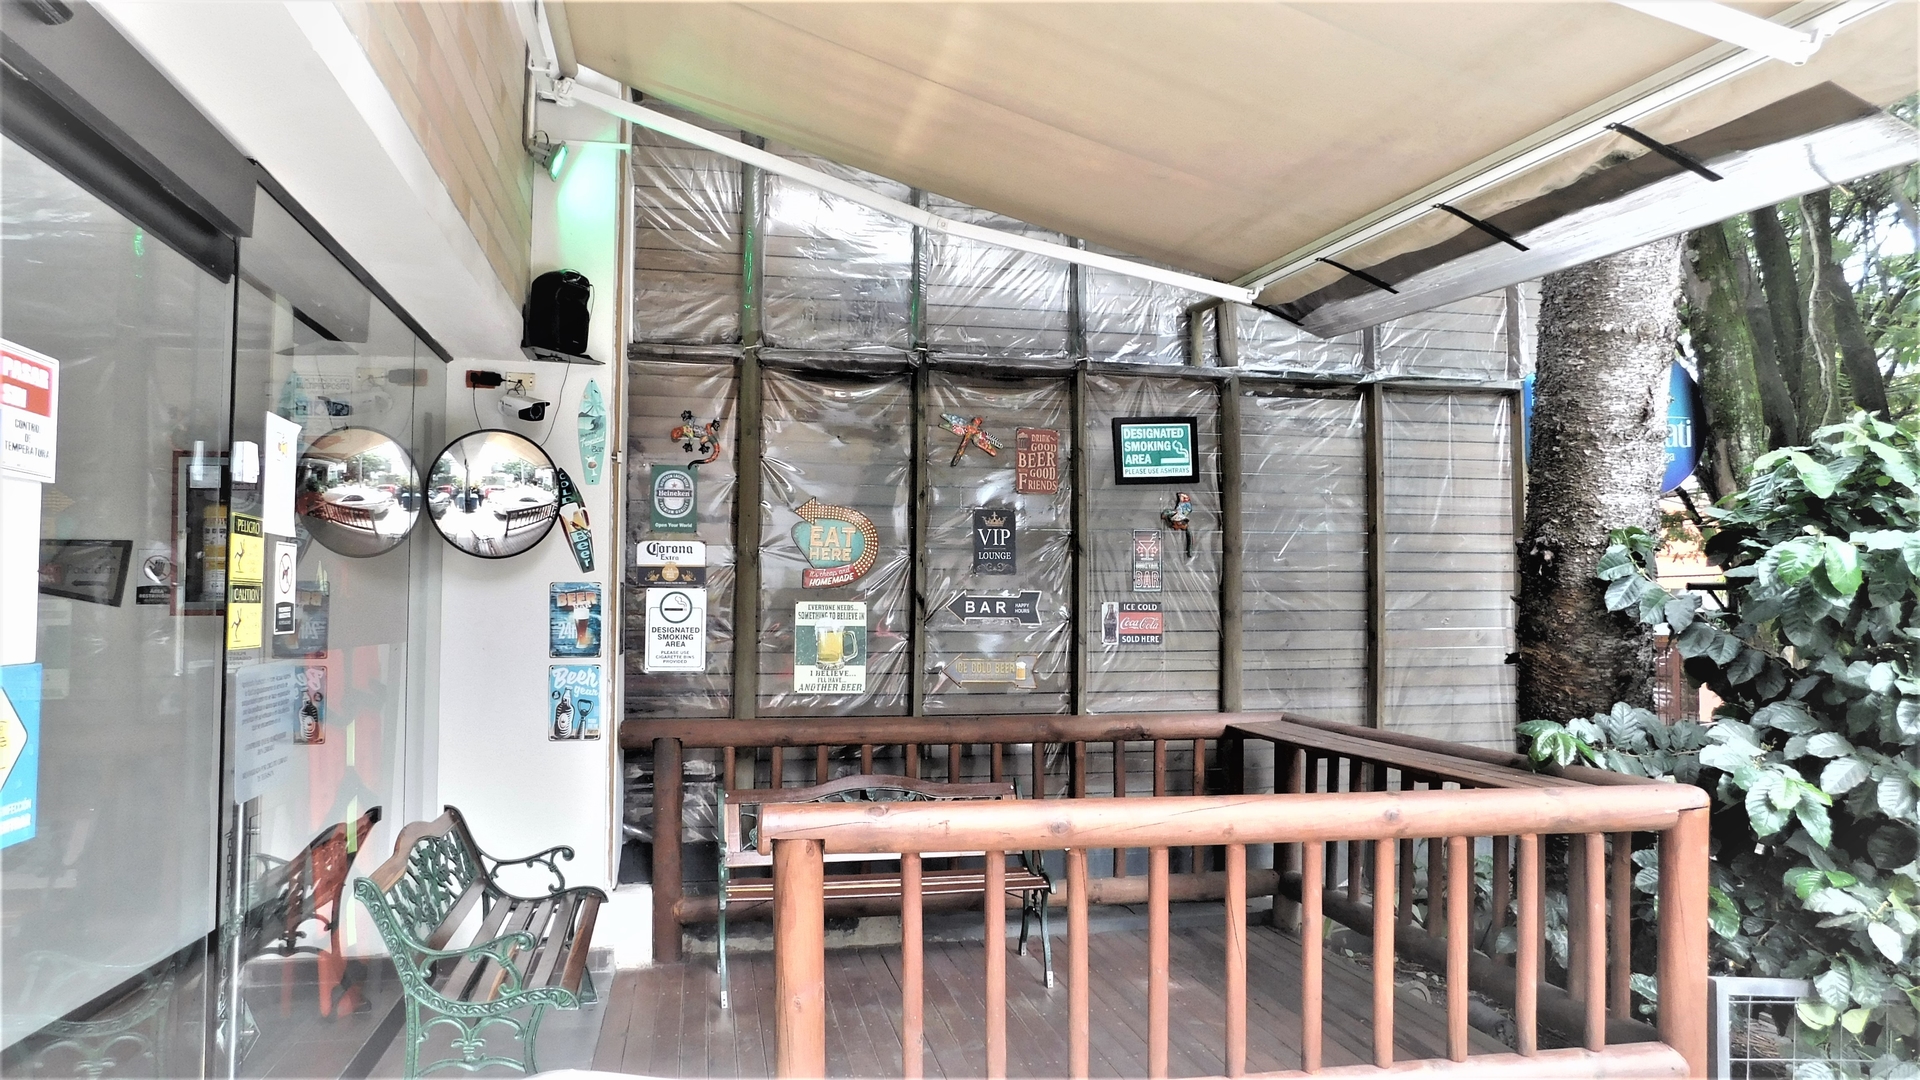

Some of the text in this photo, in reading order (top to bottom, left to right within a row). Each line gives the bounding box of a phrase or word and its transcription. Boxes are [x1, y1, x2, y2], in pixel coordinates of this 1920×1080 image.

[1031, 434, 1051, 442] DRINK
[1123, 428, 1184, 439] DESIGNATED
[1665, 419, 1691, 448] ati
[1031, 443, 1057, 452] GOOD
[1124, 441, 1171, 452] SMOKING
[1018, 452, 1056, 468] BEER
[1125, 454, 1152, 464] AREA
[1030, 467, 1056, 480] GOOD
[1018, 473, 1057, 490] FRIENDS
[237, 518, 260, 535] PELIGRO
[810, 525, 856, 547] EAT
[977, 529, 1010, 545] VIP
[646, 542, 693, 557] Corona
[809, 547, 852, 561] HERE
[809, 573, 854, 586] HOMEMADE
[1136, 571, 1159, 588] BAR
[233, 588, 260, 601] CAUTION
[557, 592, 597, 606] BEER
[965, 601, 1006, 613] BAR
[829, 612, 836, 620] TO
[837, 612, 858, 620] BELIEVE
[995, 661, 1015, 673] BEER
[552, 667, 598, 689] Beer
[574, 686, 599, 697] gear
